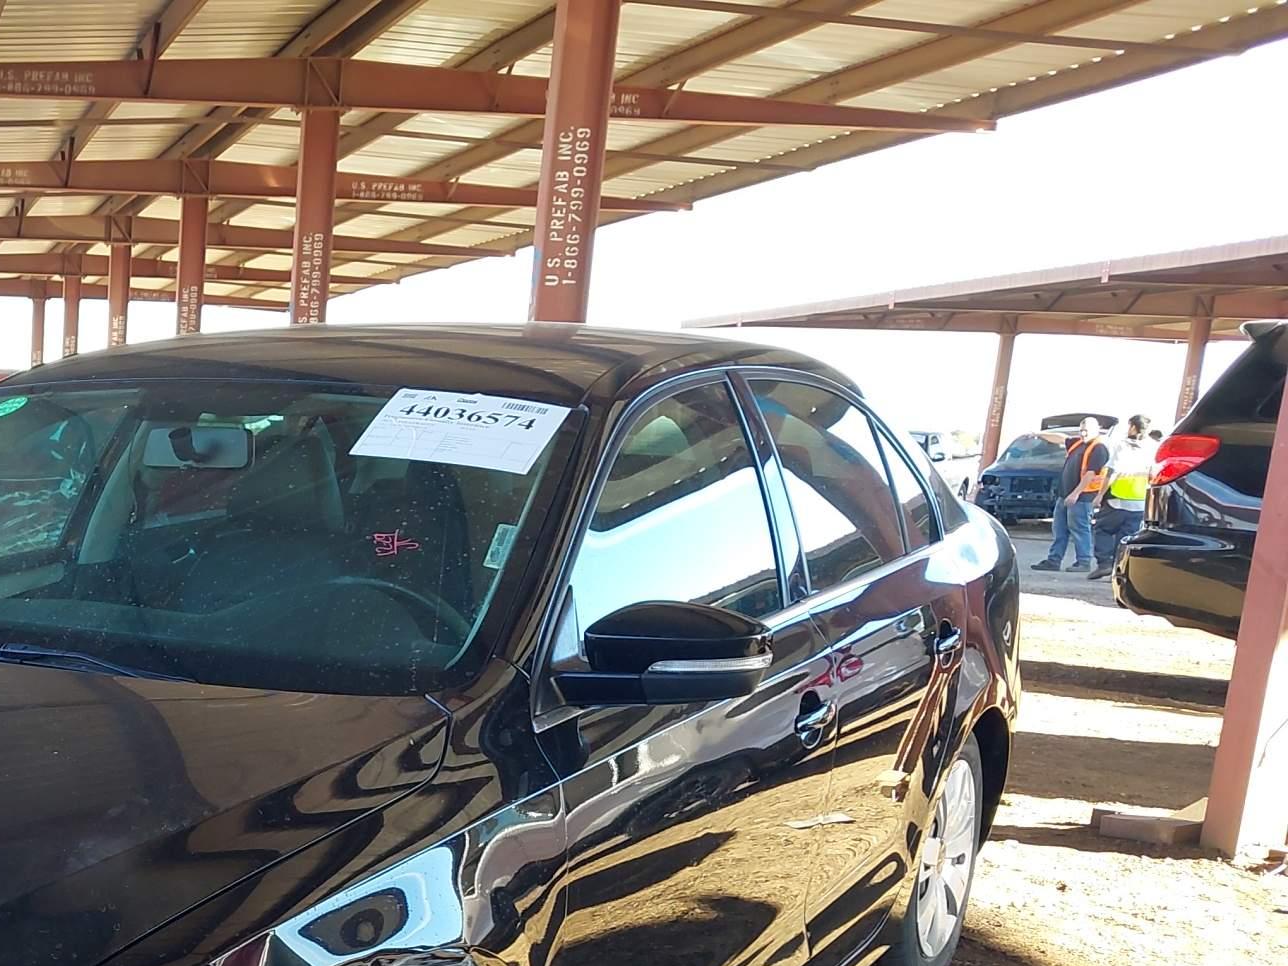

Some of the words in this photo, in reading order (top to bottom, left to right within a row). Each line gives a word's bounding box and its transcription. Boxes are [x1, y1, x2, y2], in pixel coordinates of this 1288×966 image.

[557, 126, 575, 161] INC.
[550, 170, 570, 242] PREFAB
[562, 127, 591, 285] 1-866-799-0969
[299, 261, 312, 307] PREFAB
[309, 233, 324, 324] 866-799-0969
[544, 251, 563, 286] U.S.
[400, 403, 537, 430] 44036574
